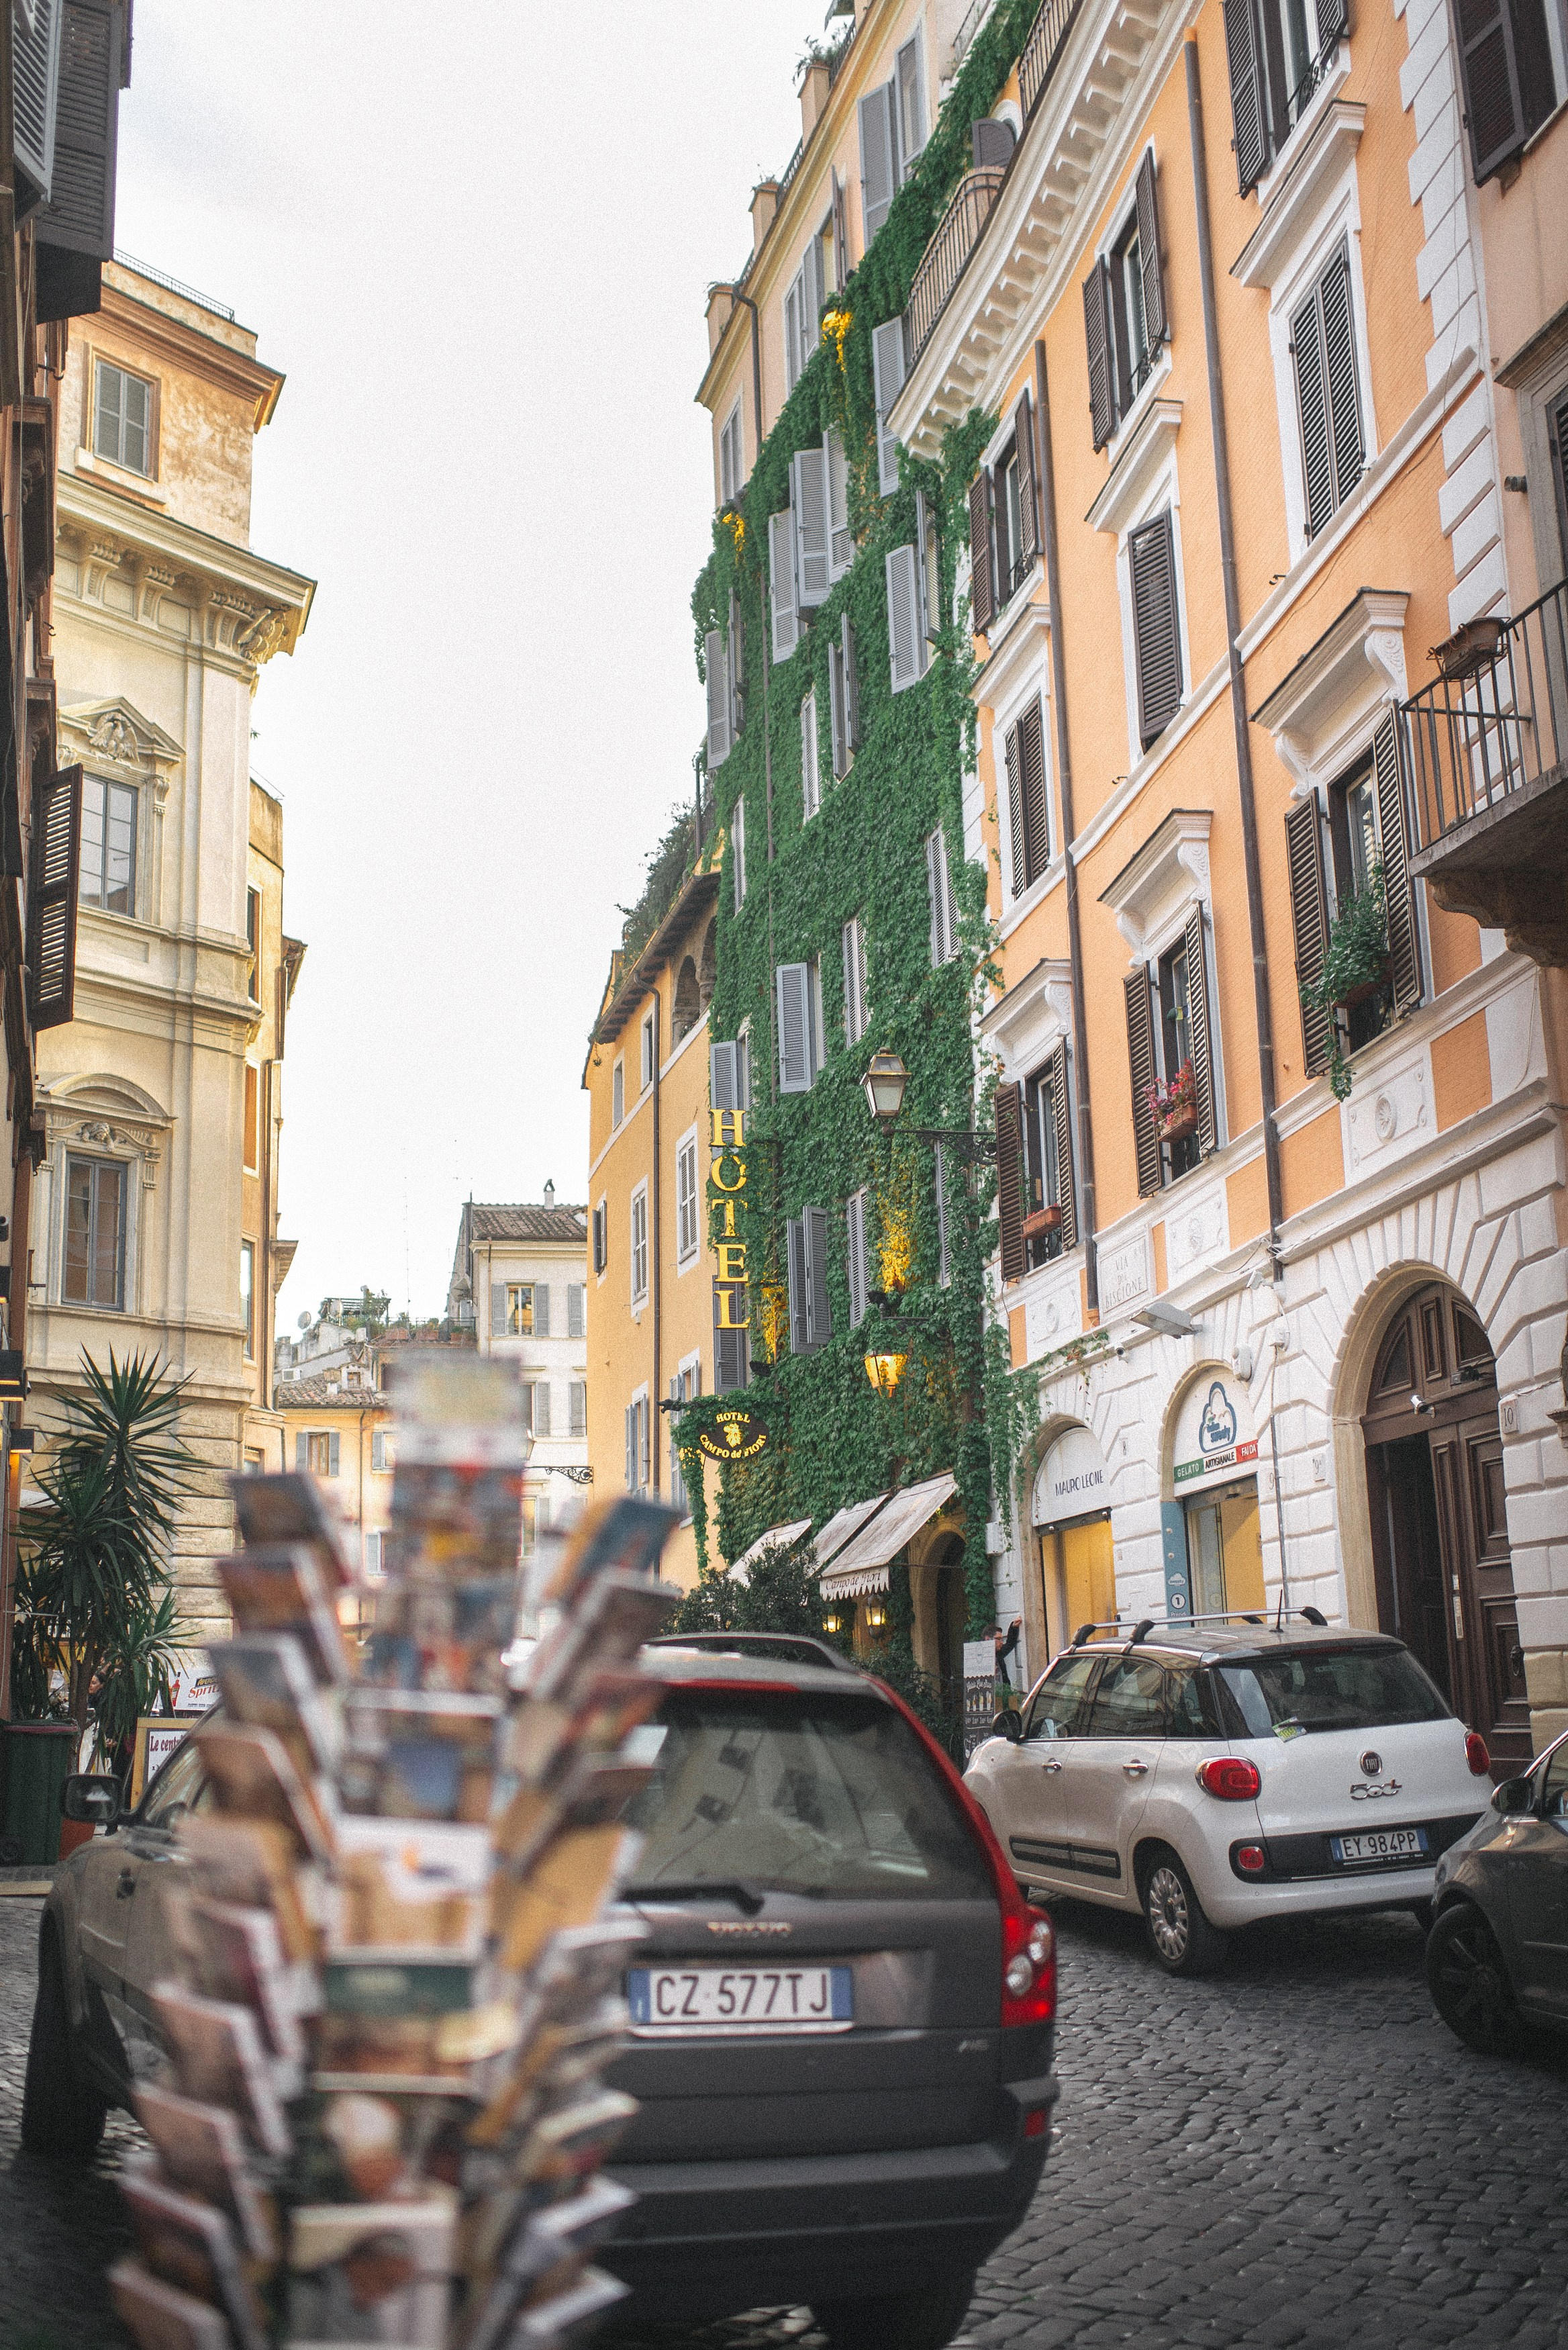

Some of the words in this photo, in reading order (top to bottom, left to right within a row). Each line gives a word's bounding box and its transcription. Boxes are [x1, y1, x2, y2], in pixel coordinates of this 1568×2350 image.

[709, 1109, 750, 1329] HOTEL
[1116, 1255, 1128, 1271] VIA
[1105, 1276, 1142, 1309] BISCIONE
[716, 1412, 750, 1423] HOTEL
[1504, 1407, 1514, 1426] 10
[699, 1434, 730, 1458] CAMPO
[730, 1449, 742, 1459] de'
[744, 1434, 767, 1457] FIORI
[1122, 1441, 1127, 1456] 8
[1177, 1463, 1199, 1478] GELATO
[1205, 1452, 1235, 1469] ARTIGIANALE
[1241, 1446, 1249, 1457] FAI
[1249, 1444, 1257, 1454] DA
[1055, 1477, 1081, 1497] MAURO
[1081, 1470, 1104, 1489] LEONE
[1269, 1472, 1275, 1490] 9
[826, 1579, 850, 1593] Campo
[861, 1569, 881, 1586] Fiori
[1175, 1597, 1180, 1605] 1
[197, 1678, 215, 1686] APERO
[150, 1736, 159, 1752] Le
[1365, 1758, 1377, 1770] FIAT
[1350, 1779, 1402, 1800] 500L
[1342, 1837, 1361, 1857] EY
[1367, 1832, 1416, 1854] 984PP
[656, 1975, 700, 2016] CZ
[717, 1973, 828, 2014] 577TJ
